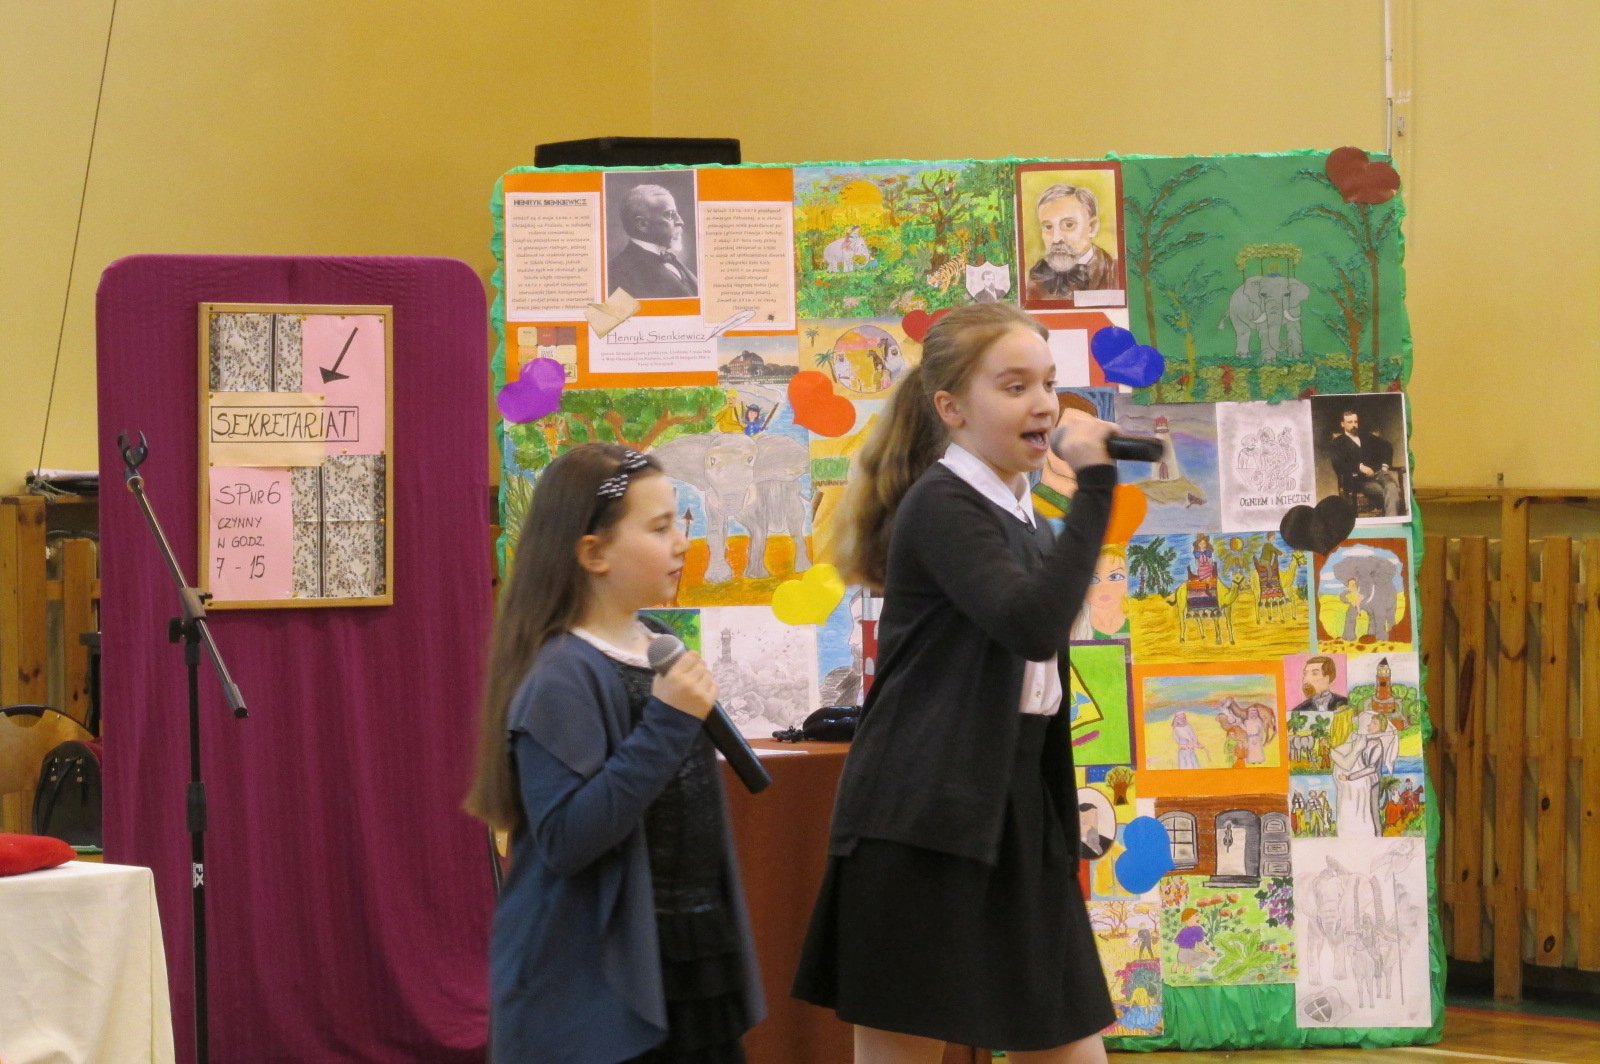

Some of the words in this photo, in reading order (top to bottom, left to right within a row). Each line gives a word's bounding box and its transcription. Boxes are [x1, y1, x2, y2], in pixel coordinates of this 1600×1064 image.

[607, 331, 645, 344] Henryk
[647, 331, 705, 343] Sienkiewicz
[217, 517, 262, 530] CZYNNY
[249, 555, 265, 578] 15
